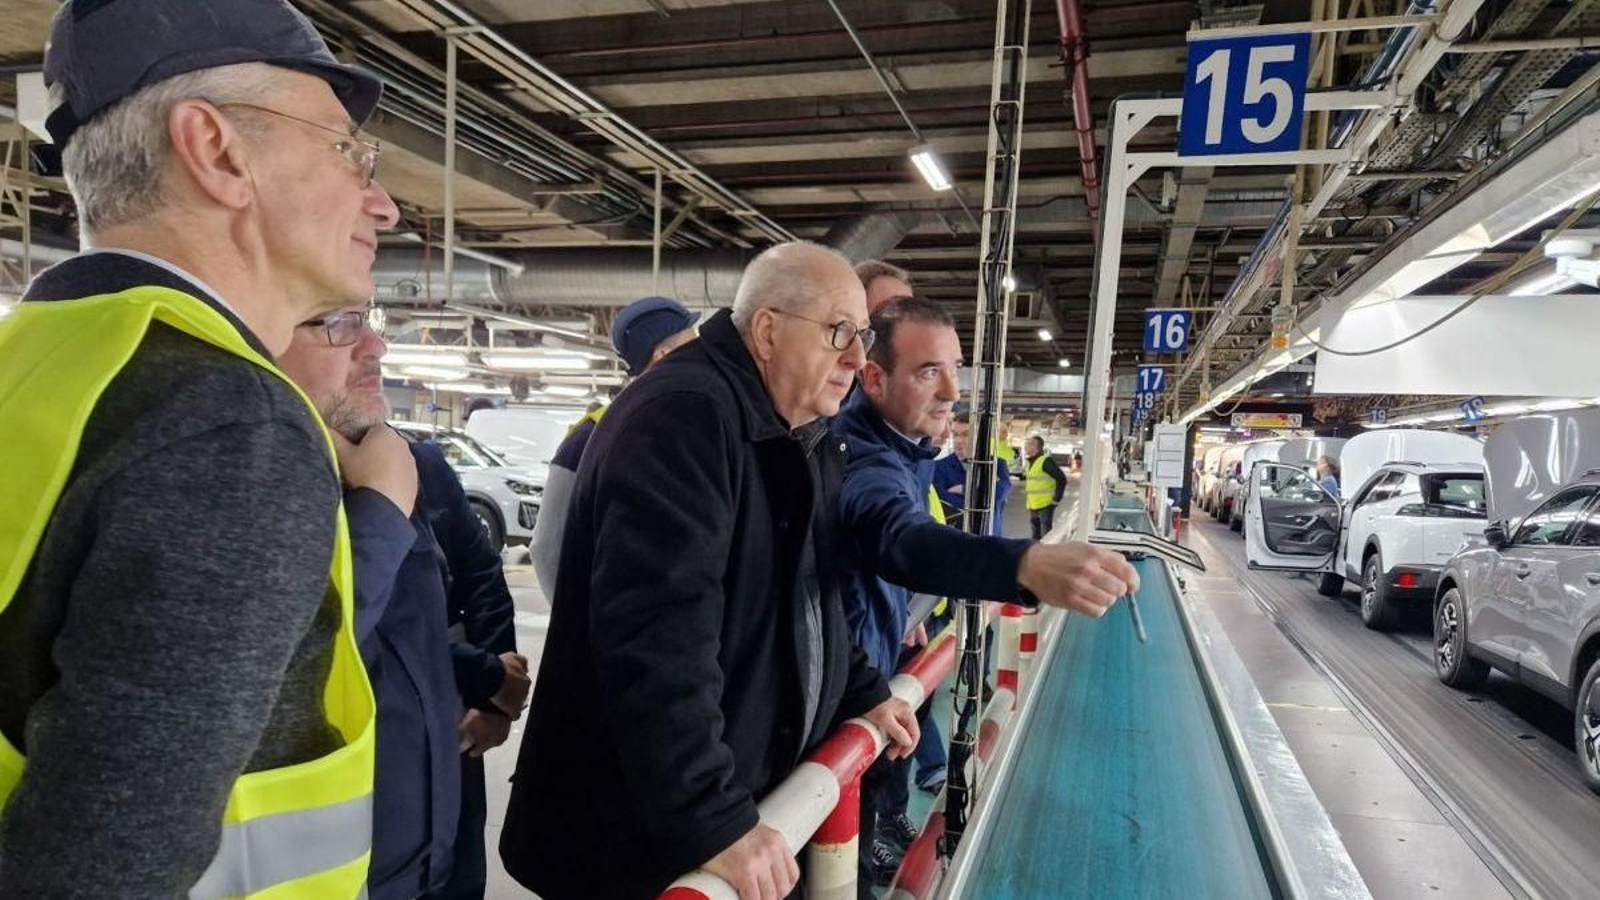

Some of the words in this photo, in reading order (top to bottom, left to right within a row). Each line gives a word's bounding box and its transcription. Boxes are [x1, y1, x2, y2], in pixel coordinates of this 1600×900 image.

[1195, 45, 1295, 145] 15
[1149, 313, 1185, 349] 16
[1140, 368, 1163, 390] 17
[1137, 392, 1154, 409] 18
